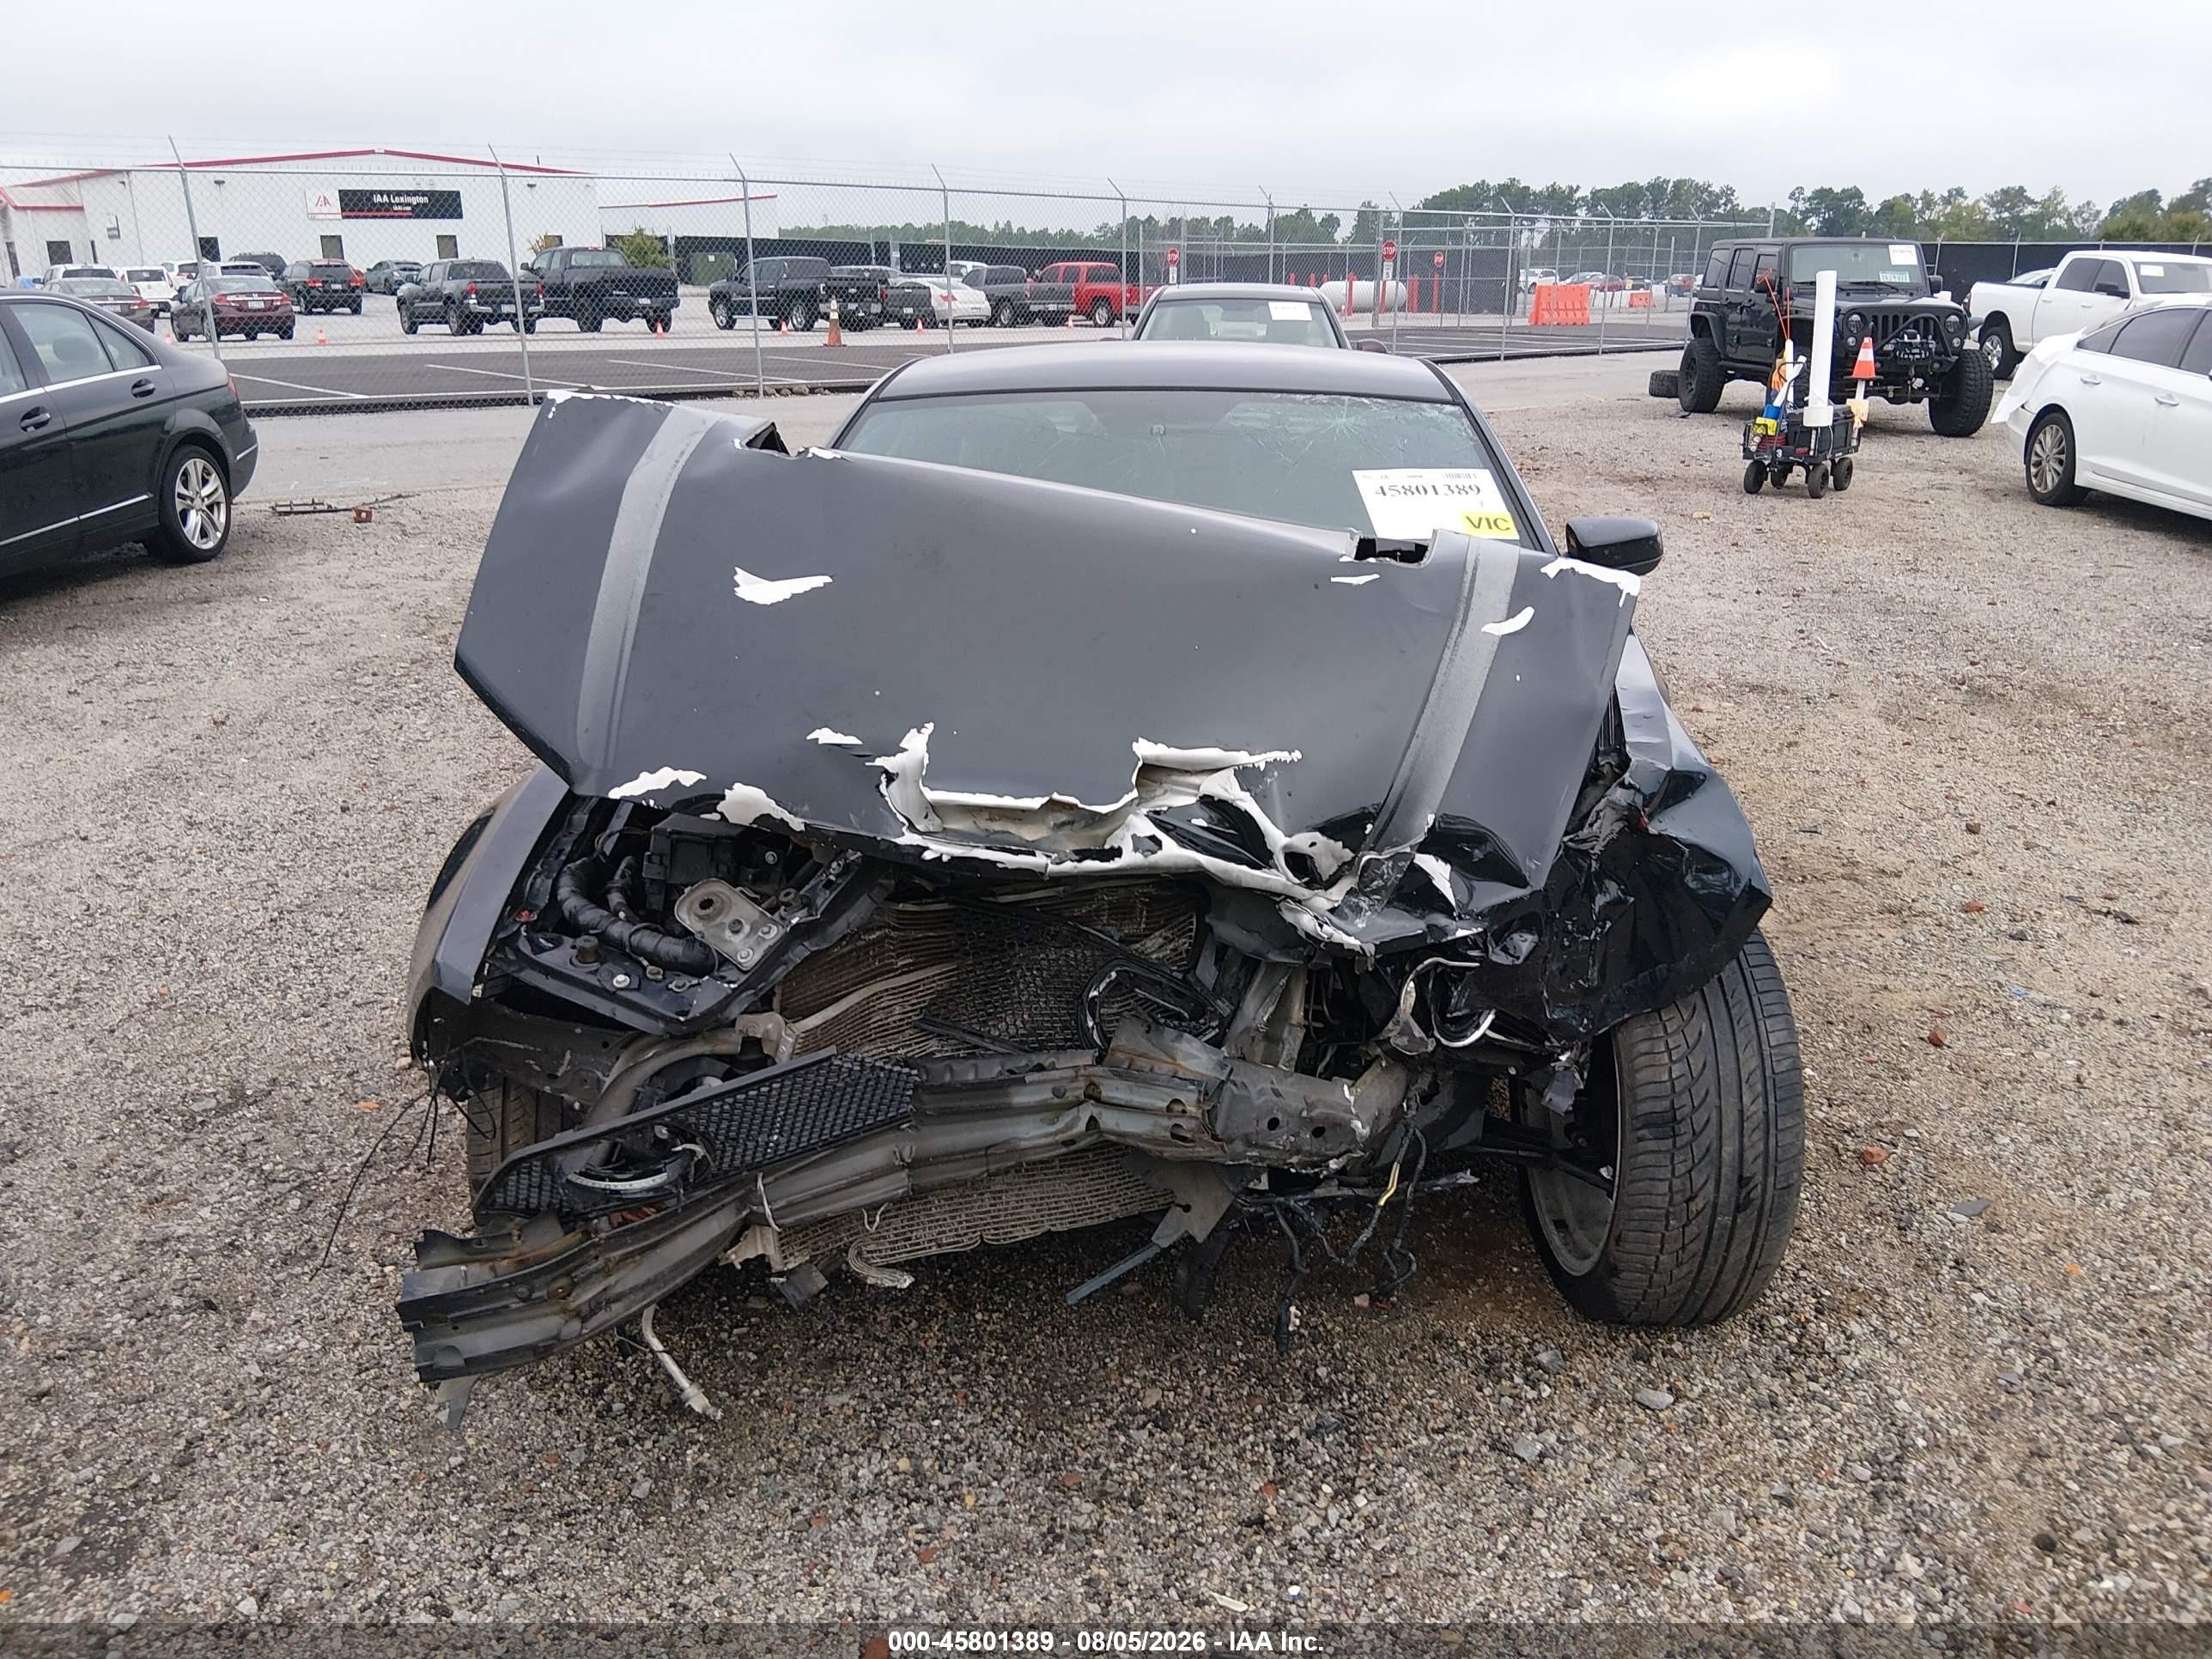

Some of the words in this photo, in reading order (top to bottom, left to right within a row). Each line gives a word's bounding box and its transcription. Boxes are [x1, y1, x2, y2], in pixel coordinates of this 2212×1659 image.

[373, 193, 389, 204] IAA
[391, 193, 429, 205] Lexington
[1383, 246, 1396, 255] STOP
[1776, 448, 1782, 457] 3
[1376, 483, 1481, 497] 45801389
[1465, 515, 1511, 532] VIC
